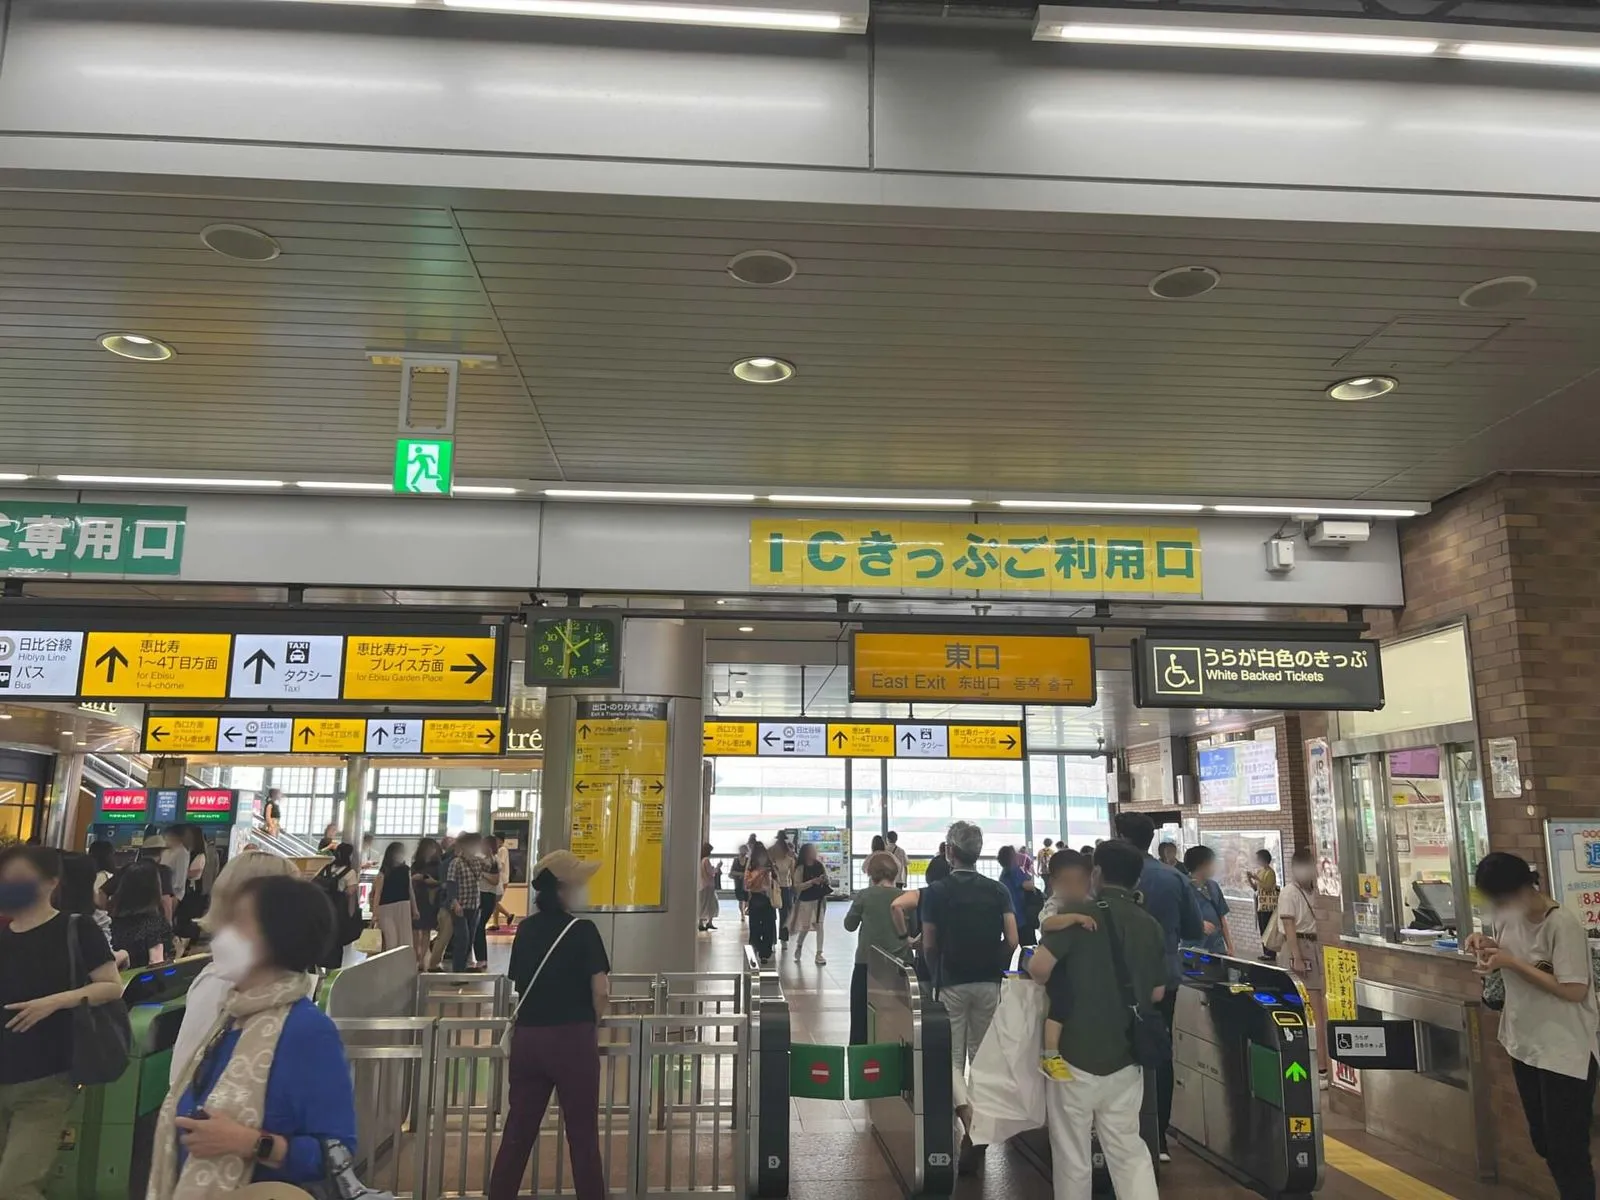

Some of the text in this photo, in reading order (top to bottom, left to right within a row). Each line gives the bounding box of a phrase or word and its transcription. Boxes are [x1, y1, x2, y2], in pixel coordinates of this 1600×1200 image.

[0, 512, 177, 560] 専用口
[769, 530, 1194, 579] ICきっぷご利用口
[20, 637, 72, 652] 日比谷線
[140, 640, 180, 653] 恵比寿
[357, 643, 446, 656] 恵比寿ガーデン
[18, 653, 66, 662] Hibiya Line
[944, 642, 1000, 670] 東口
[1204, 648, 1368, 668] うらが白色のきっぷ
[370, 658, 444, 672] プレイス方面
[16, 666, 45, 679] バス
[284, 670, 332, 682] タクシー
[369, 674, 389, 682] Ebisu
[392, 674, 420, 682] Garden
[1206, 669, 1324, 682] White Backed Tickets
[14, 681, 31, 689] Bus
[284, 684, 300, 692] Taxi
[871, 673, 947, 690] East Exit
[958, 676, 1000, 690] 东出口
[1013, 677, 1075, 692] 동쪽 출구
[769, 1158, 777, 1166] 3
